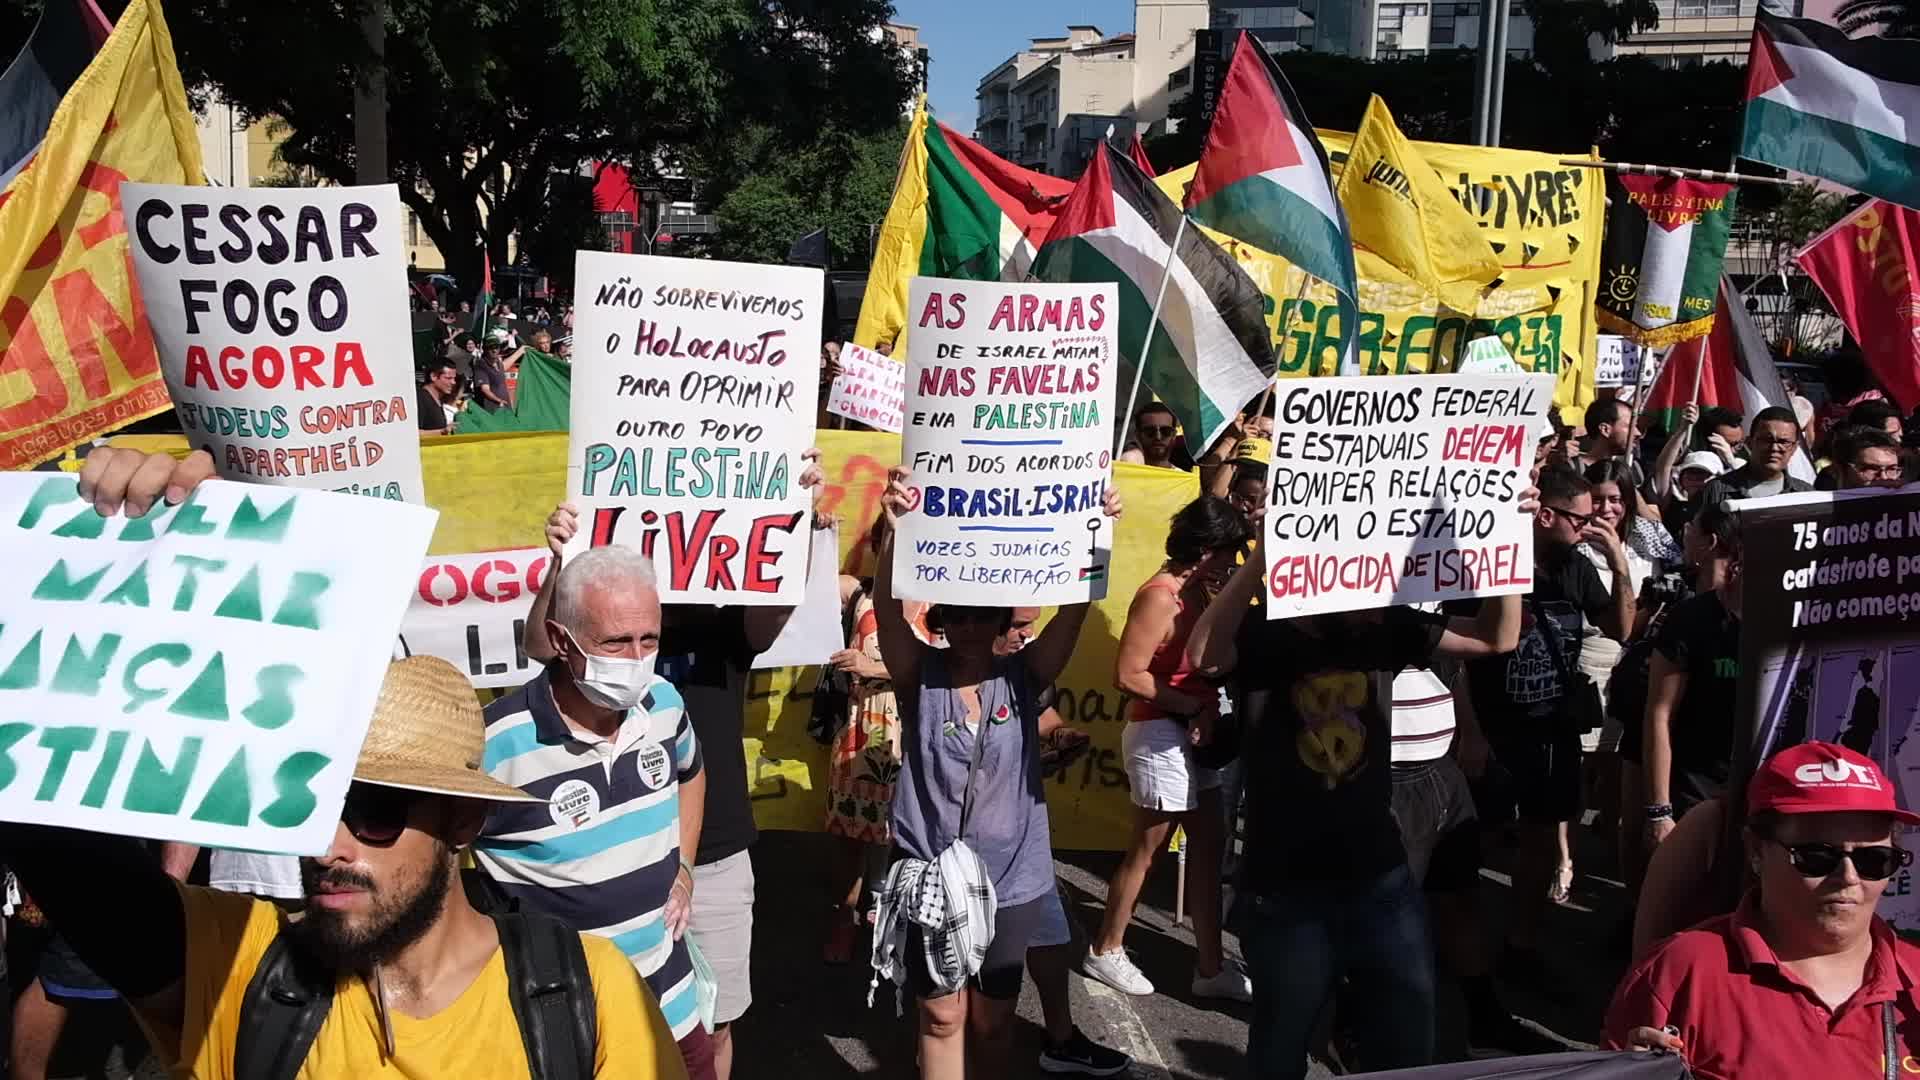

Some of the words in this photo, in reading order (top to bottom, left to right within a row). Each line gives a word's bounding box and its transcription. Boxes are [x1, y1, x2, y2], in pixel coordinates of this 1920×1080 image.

[1626, 191, 1724, 211] PALESTINA
[1646, 208, 1703, 225] LIVRE
[136, 198, 380, 265] CESSAR
[180, 275, 348, 337] FOGO
[594, 276, 643, 309] NÃO
[1684, 296, 1712, 311] MES
[918, 292, 967, 330] AS
[988, 293, 1105, 332] ARMAS
[606, 333, 620, 354] O
[937, 343, 965, 359] DE
[976, 344, 1047, 359] ISRAEL
[1052, 345, 1099, 359] MATAM
[185, 342, 374, 391] AGORA
[918, 365, 976, 397] NAS
[988, 362, 1100, 395] FAVELAS
[616, 374, 670, 397] PARA
[182, 403, 290, 439] JUDEUS
[300, 396, 407, 434] CONTRA
[912, 412, 925, 426] E
[929, 411, 955, 428] NA
[1283, 387, 1423, 427] GOVERNOS
[1431, 385, 1537, 418] FEDERAL
[616, 420, 685, 439] OUTRO
[700, 419, 763, 443] POVO
[1276, 431, 1296, 459] E
[1302, 431, 1429, 468] ESTADUAIS
[1442, 423, 1525, 467] DEVEM
[967, 454, 1005, 474] DOS
[1016, 451, 1093, 472] ACORDOS
[1272, 467, 1376, 508] ROMPER
[1389, 465, 1517, 503] RELAÇÕES
[1274, 513, 1339, 542] COM
[1357, 511, 1377, 539] O
[1387, 507, 1496, 540] ESTADO
[1792, 521, 1818, 551] 75
[1823, 520, 1870, 546] anos
[1874, 513, 1902, 539] da
[915, 539, 977, 557] VOZES
[915, 564, 950, 582] POR
[1270, 552, 1398, 599] GENOCIDA
[1403, 552, 1432, 577] DE
[1434, 543, 1531, 592] ISRAEL
[1782, 553, 1890, 591] catástrofe
[31, 554, 332, 630] MATAR
[1792, 599, 1832, 628] Não
[1795, 758, 1874, 784] CUT
